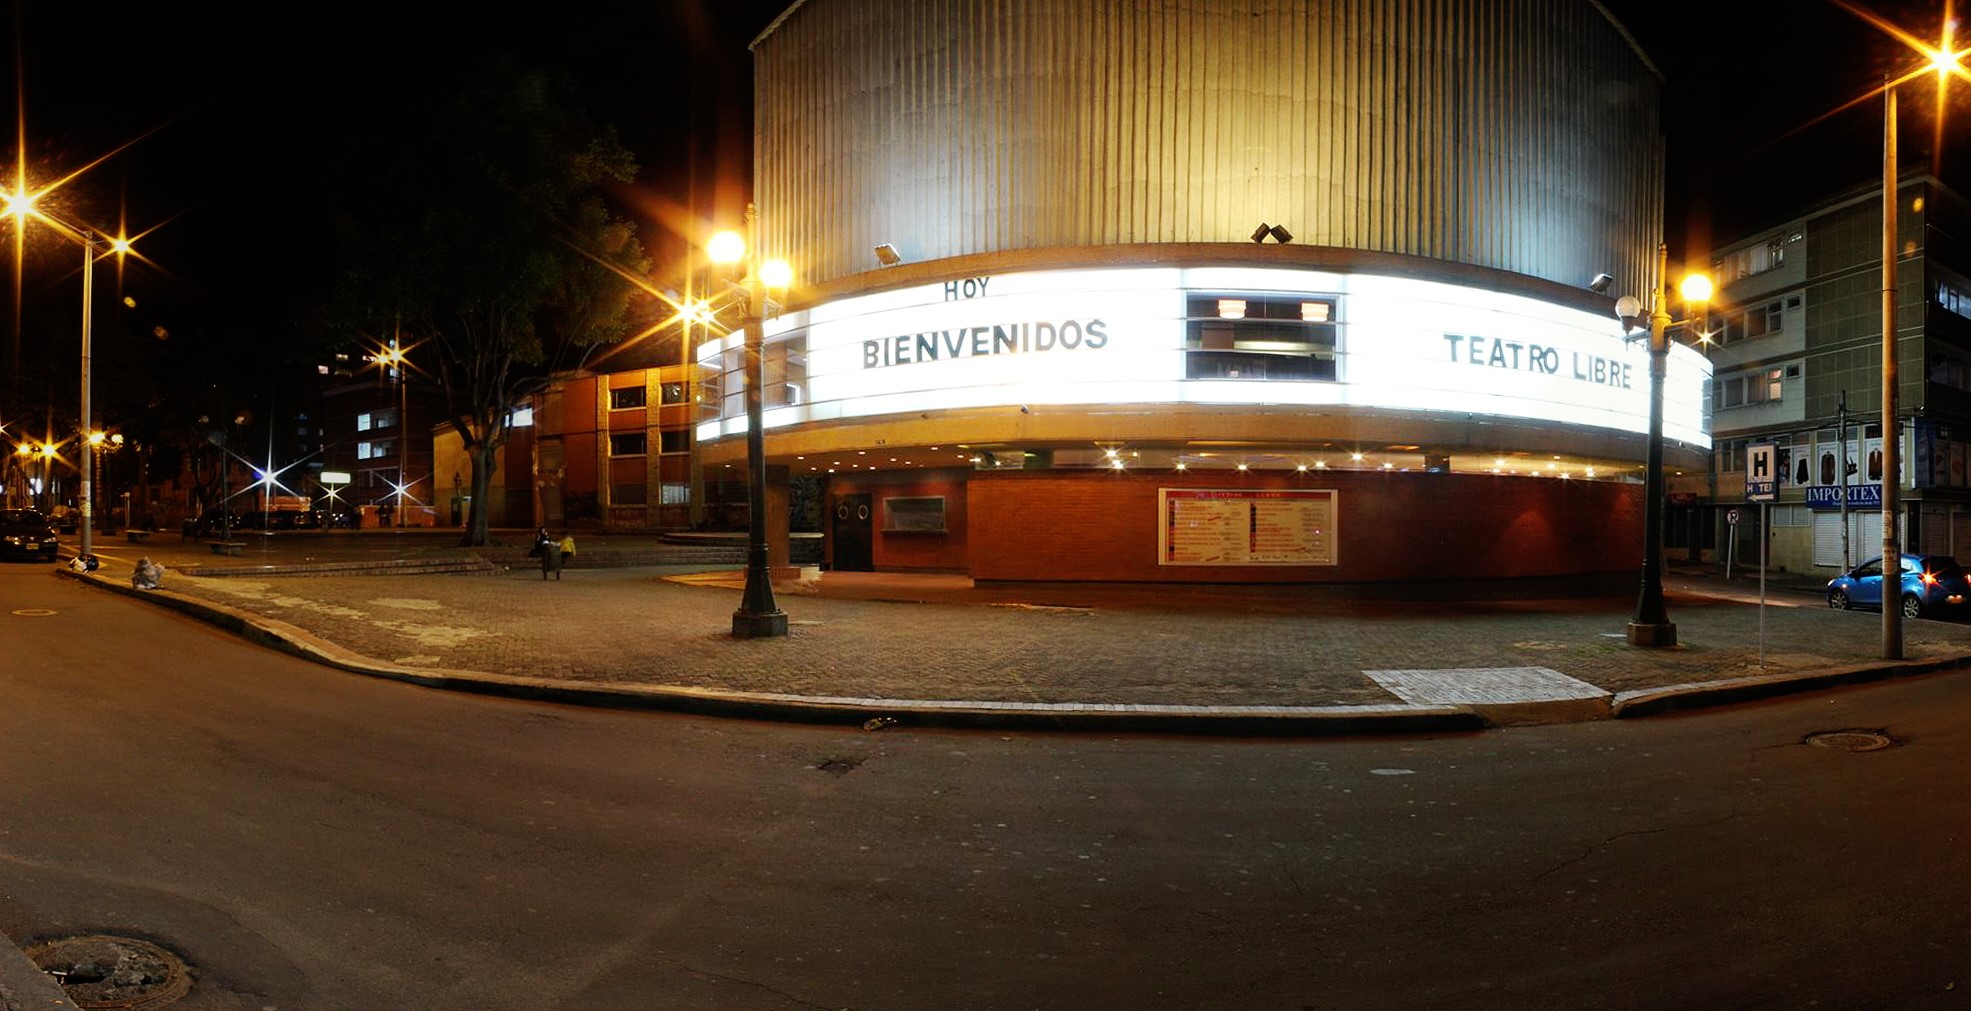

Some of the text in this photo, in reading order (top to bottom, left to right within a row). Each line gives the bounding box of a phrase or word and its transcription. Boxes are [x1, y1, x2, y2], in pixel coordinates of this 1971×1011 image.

[944, 277, 990, 301] HOY
[863, 319, 1108, 369] BIENVENIDOS
[1443, 334, 1632, 389] TEATRO LIBRE
[1754, 452, 1767, 476] H
